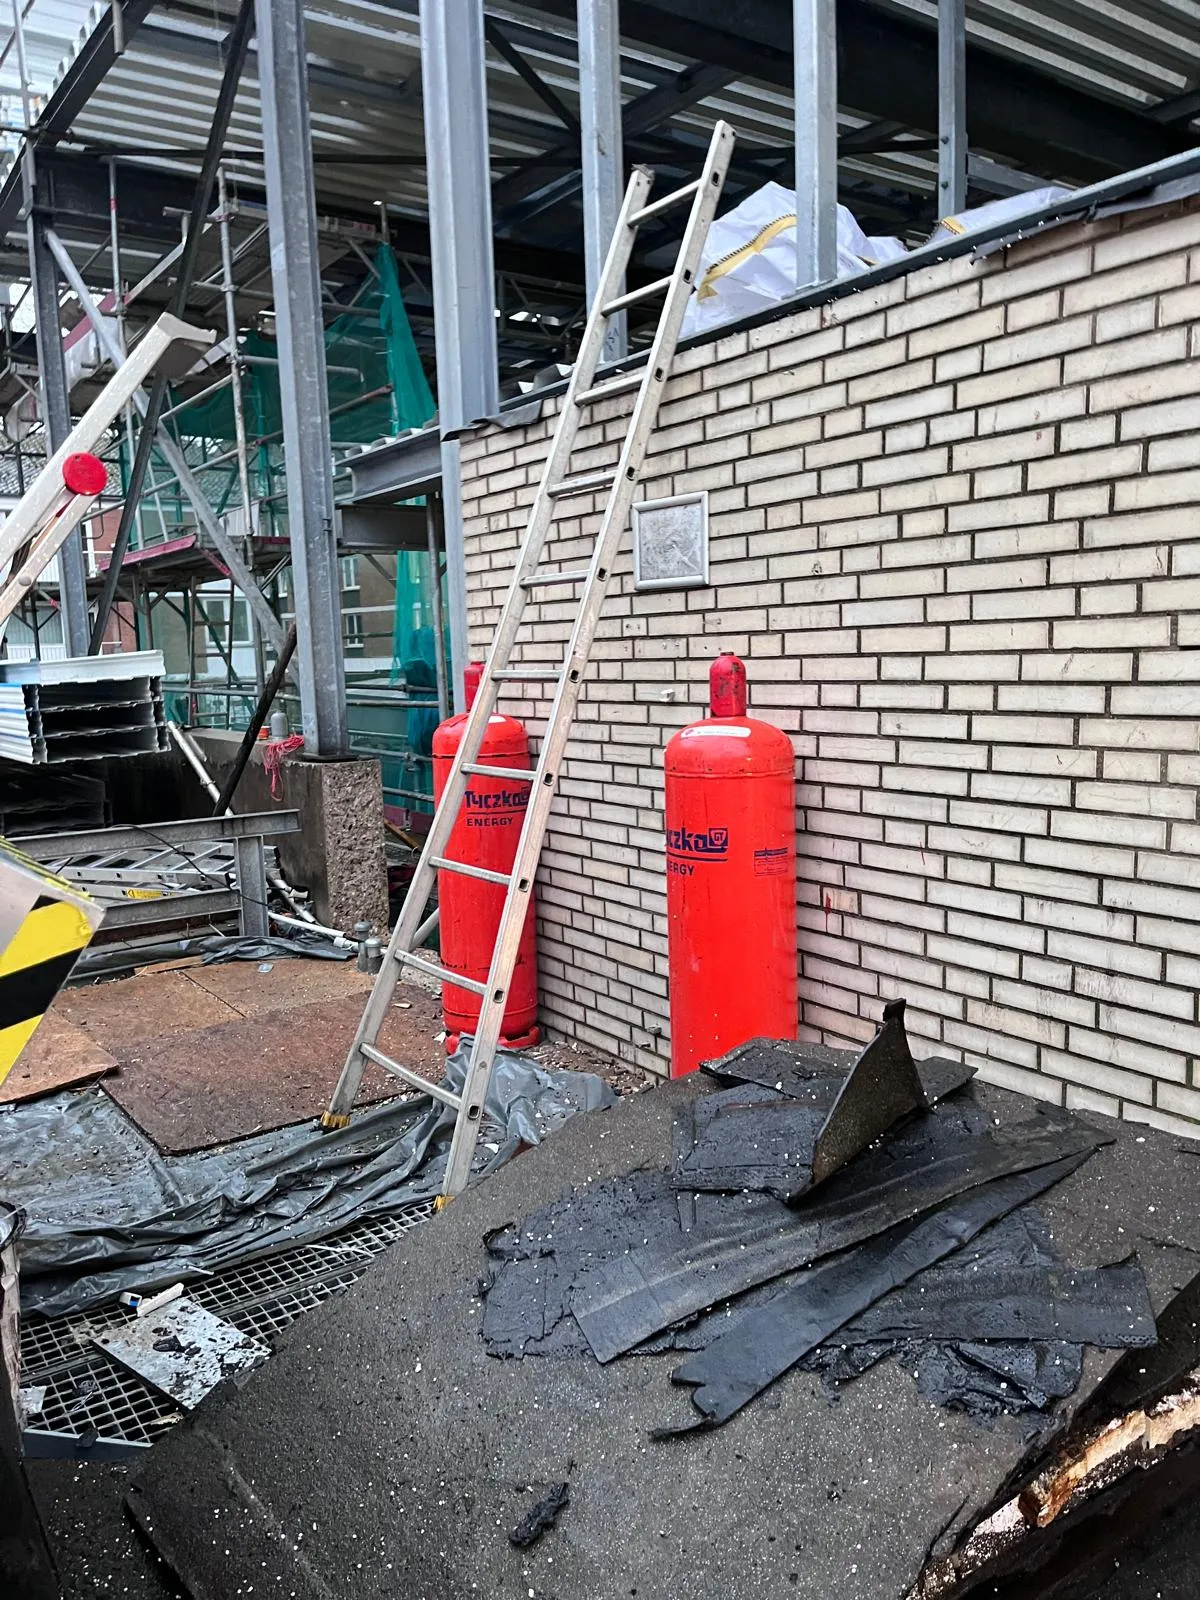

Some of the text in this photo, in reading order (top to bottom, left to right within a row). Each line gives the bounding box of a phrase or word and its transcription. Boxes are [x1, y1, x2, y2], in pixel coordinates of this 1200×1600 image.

[465, 790, 526, 808] Tyczka
[466, 817, 513, 827] ENERGY
[668, 861, 694, 876] ERGY
